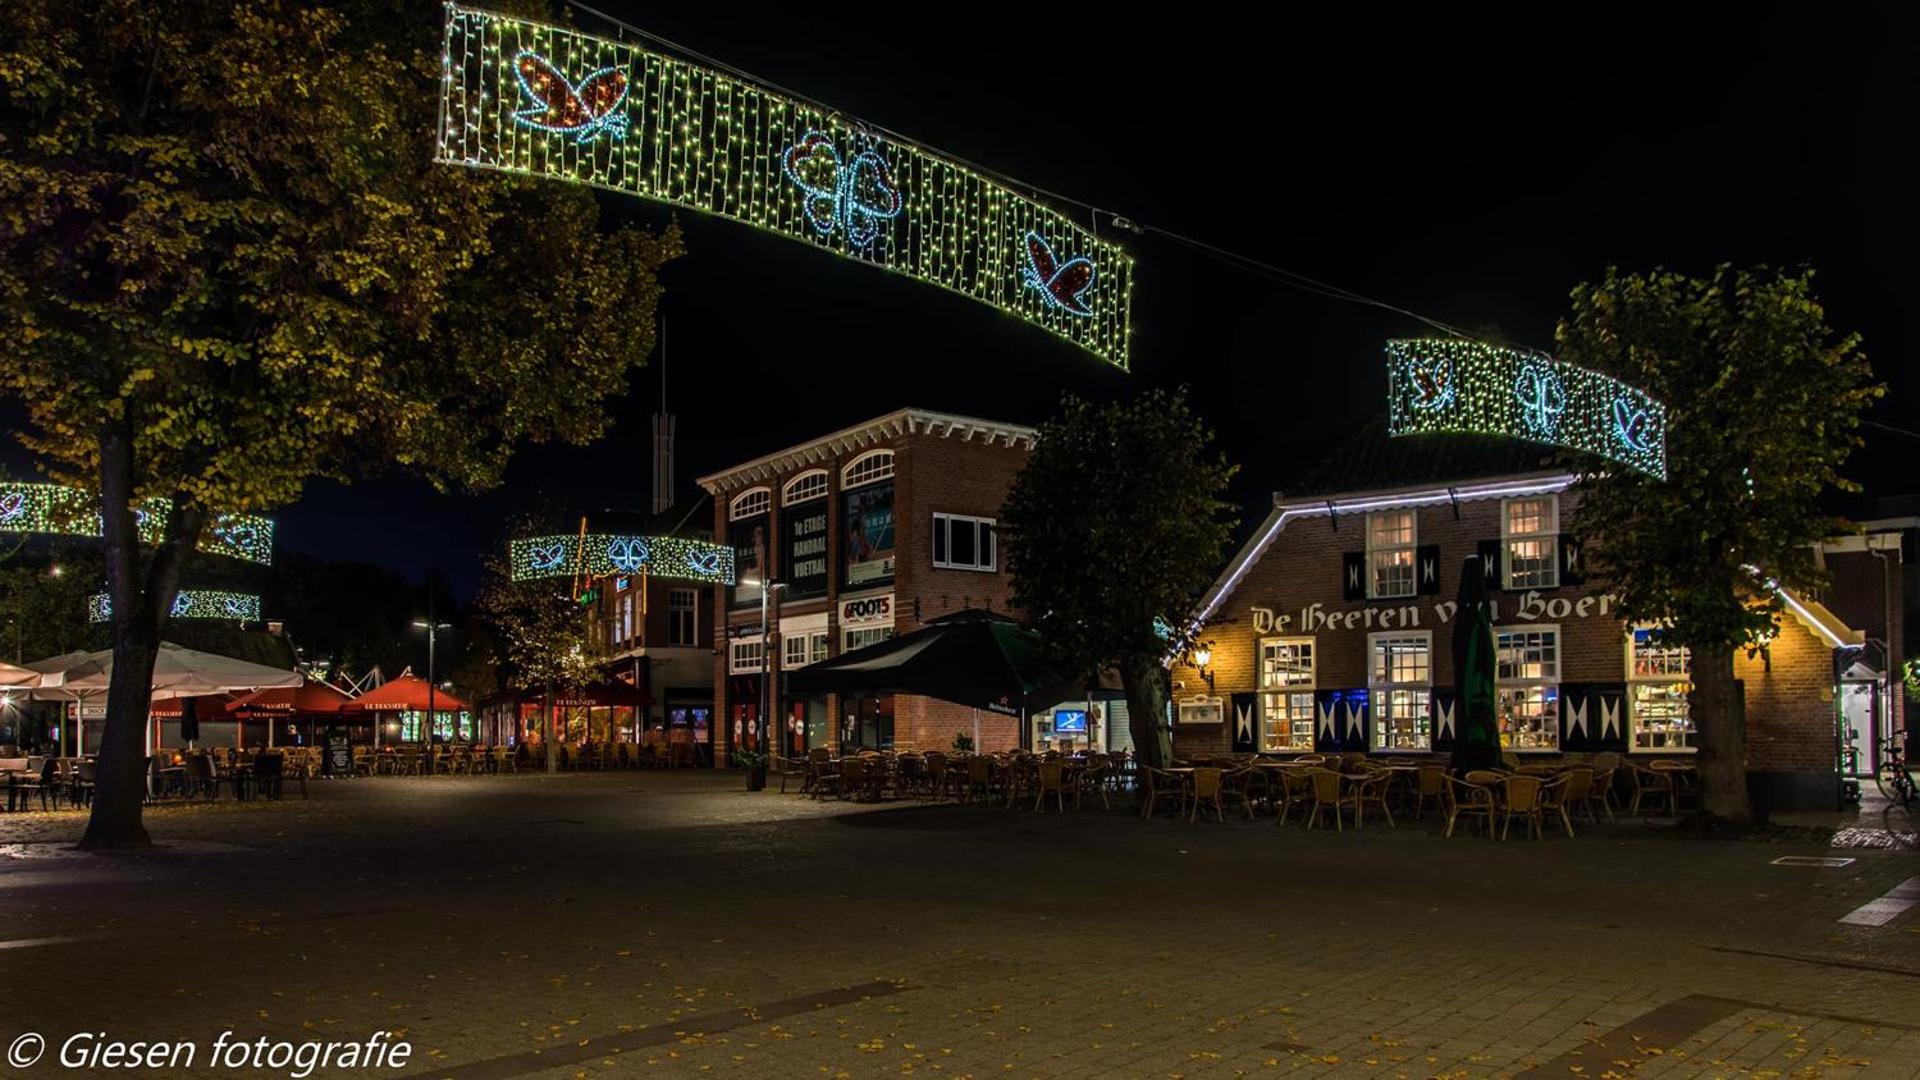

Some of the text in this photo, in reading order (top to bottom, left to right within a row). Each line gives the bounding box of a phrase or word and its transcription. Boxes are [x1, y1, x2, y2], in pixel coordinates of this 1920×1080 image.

[804, 514, 826, 534] ETAGE
[794, 557, 826, 578] VOETBAL
[1251, 607, 1292, 634] De
[1301, 603, 1421, 633] Heeren
